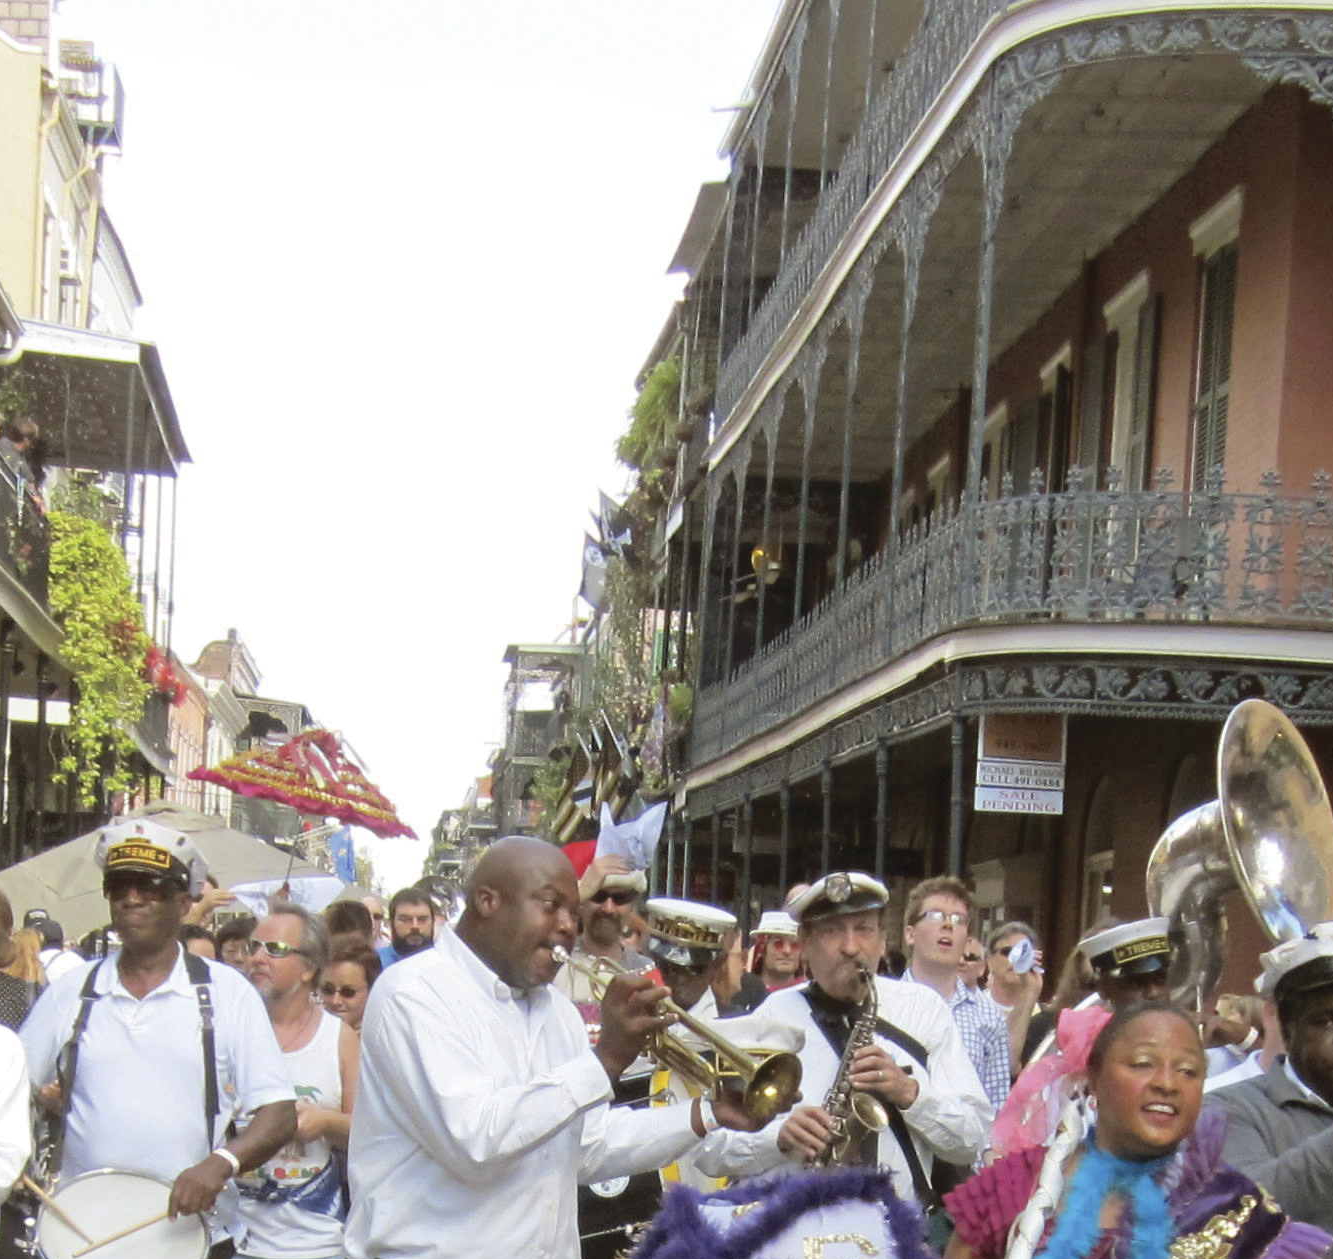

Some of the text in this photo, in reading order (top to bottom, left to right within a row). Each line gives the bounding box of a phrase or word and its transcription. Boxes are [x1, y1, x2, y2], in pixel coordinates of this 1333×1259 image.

[980, 763, 1015, 775] MICHAEL
[999, 790, 1037, 801] SALE
[982, 799, 1057, 813] PENDING
